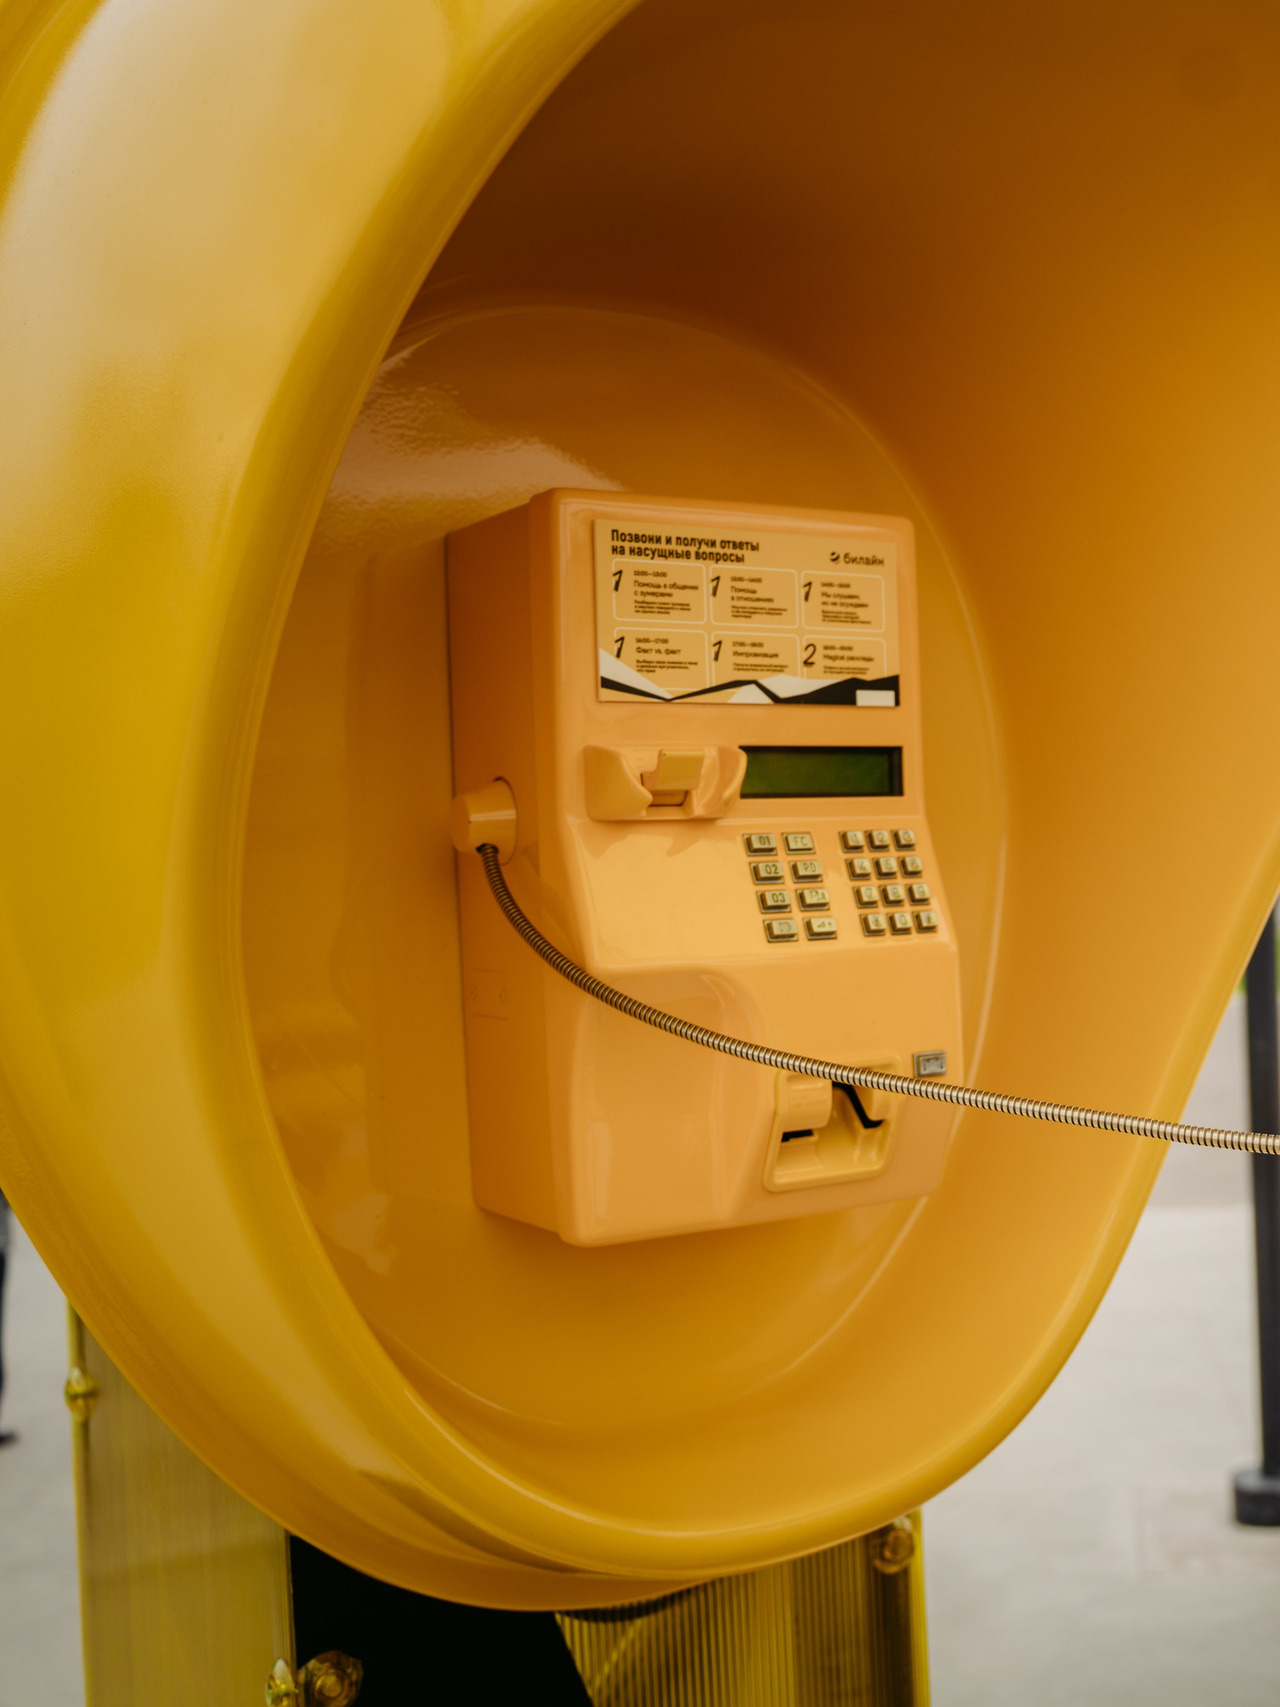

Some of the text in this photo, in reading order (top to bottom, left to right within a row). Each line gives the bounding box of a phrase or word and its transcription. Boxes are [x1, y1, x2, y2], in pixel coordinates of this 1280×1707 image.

[611, 529, 760, 552] Позвони и получи ответы
[611, 544, 745, 564] на насущные вопросы
[843, 552, 885, 567] билайн
[613, 570, 623, 592] 1
[634, 580, 662, 590] Помощь
[711, 575, 721, 597] 1
[803, 581, 813, 602] 1
[614, 636, 625, 659] 1
[636, 647, 652, 655] Факт
[713, 640, 722, 662] 1
[803, 643, 817, 665] 2
[759, 836, 770, 846] 01
[794, 836, 808, 846] FC
[765, 864, 779, 875] 02
[772, 893, 786, 903] 03
